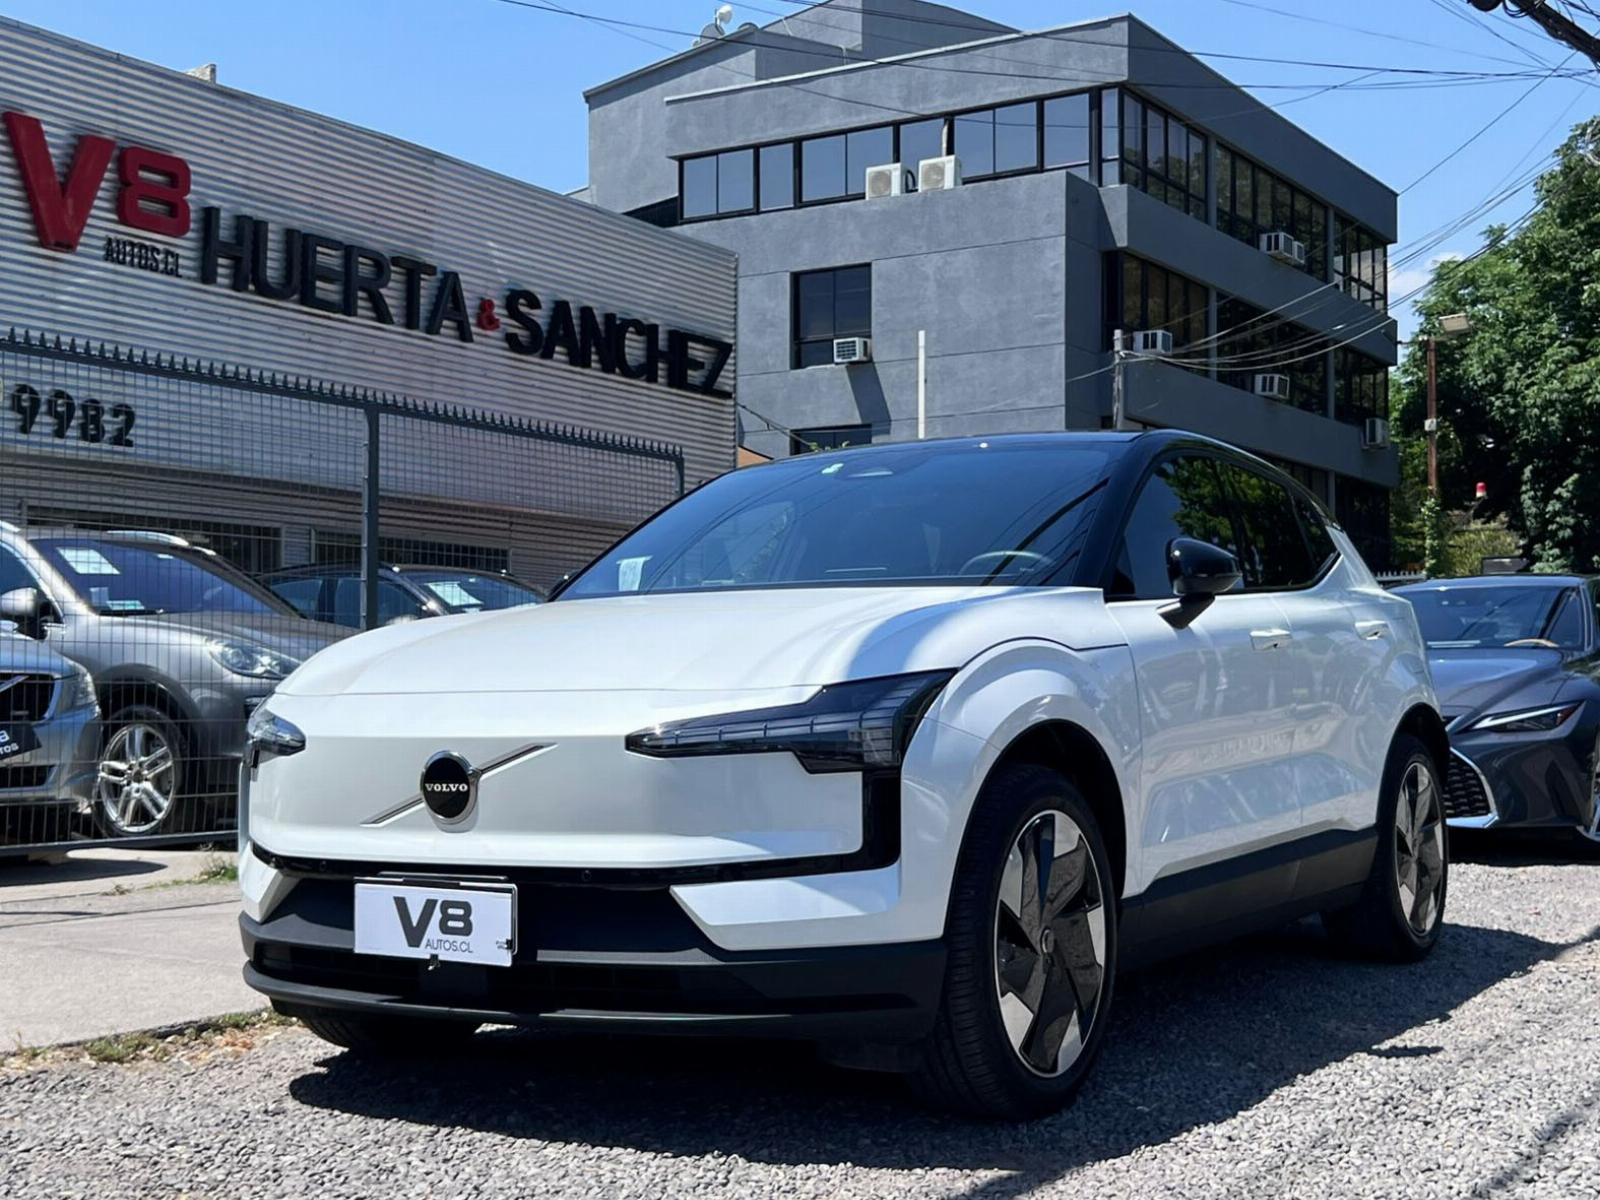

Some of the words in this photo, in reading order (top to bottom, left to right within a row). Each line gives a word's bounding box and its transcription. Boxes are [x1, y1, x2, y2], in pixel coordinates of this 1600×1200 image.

[3, 111, 191, 252] V8
[104, 236, 182, 278] AUTOS.CL
[201, 206, 474, 343] HUERTA
[477, 298, 501, 332] &
[504, 288, 733, 400] SANCHEZ
[11, 384, 136, 447] 9982
[424, 783, 468, 792] VOLVO
[393, 896, 473, 948] V8
[425, 938, 473, 953] AUTOS.CL
